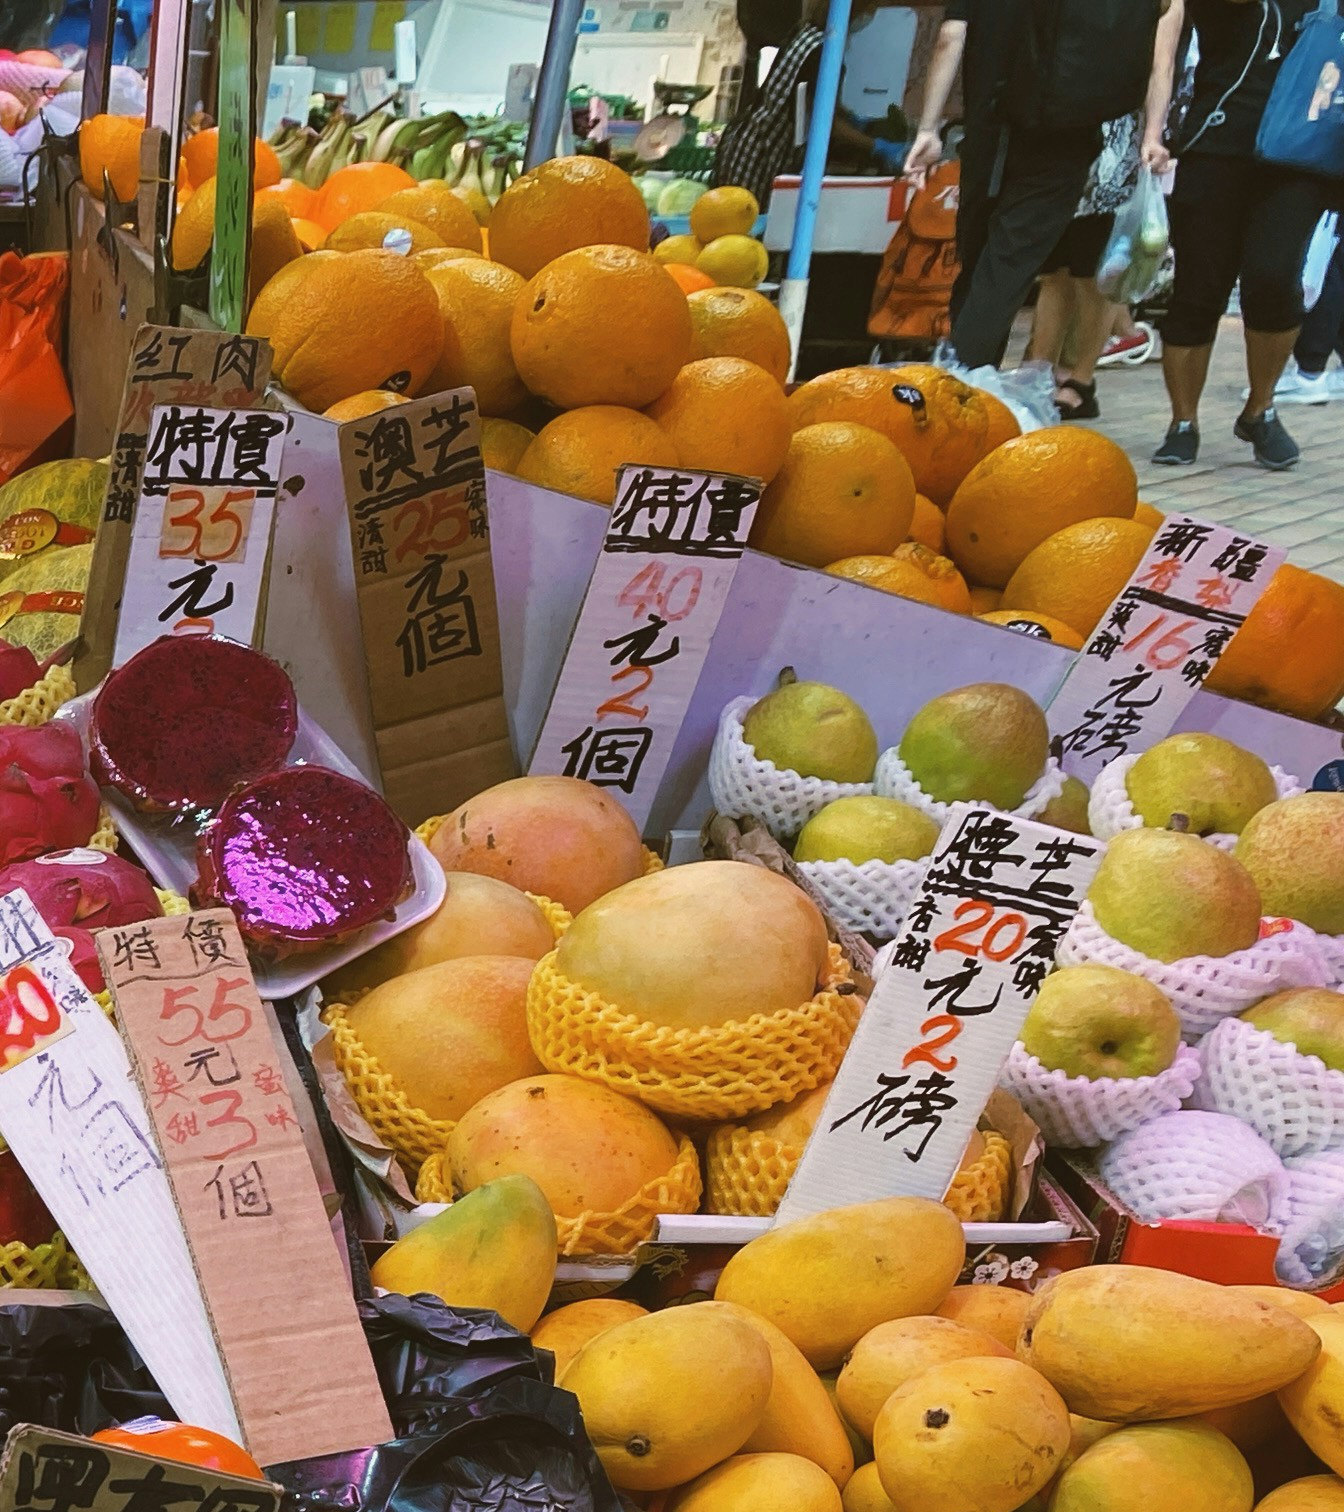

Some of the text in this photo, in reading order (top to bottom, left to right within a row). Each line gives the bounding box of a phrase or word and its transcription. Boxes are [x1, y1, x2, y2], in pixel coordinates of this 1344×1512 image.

[145, 406, 286, 484] 特價
[157, 488, 257, 563] 35
[392, 491, 471, 565] 25
[611, 468, 763, 542] 特價
[157, 559, 234, 622] 元
[403, 553, 470, 614] 元
[615, 559, 704, 624] 40
[395, 594, 484, 679] 個
[603, 612, 681, 668] 元
[1121, 613, 1198, 671] 16
[595, 663, 651, 723] 2
[1094, 662, 1164, 710] 元
[561, 725, 654, 795] 個
[1062, 706, 1144, 770] 磅
[113, 916, 235, 972] 特價
[933, 899, 1029, 964] 20
[157, 976, 254, 1047] 55
[922, 957, 1005, 1017] 元
[183, 1046, 243, 1087] 元
[901, 1014, 964, 1073] 2
[27, 1052, 103, 1136] 元
[198, 1088, 259, 1162] 3
[828, 1071, 960, 1164] 磅
[60, 1099, 164, 1208] 個
[203, 1159, 274, 1221] 個
